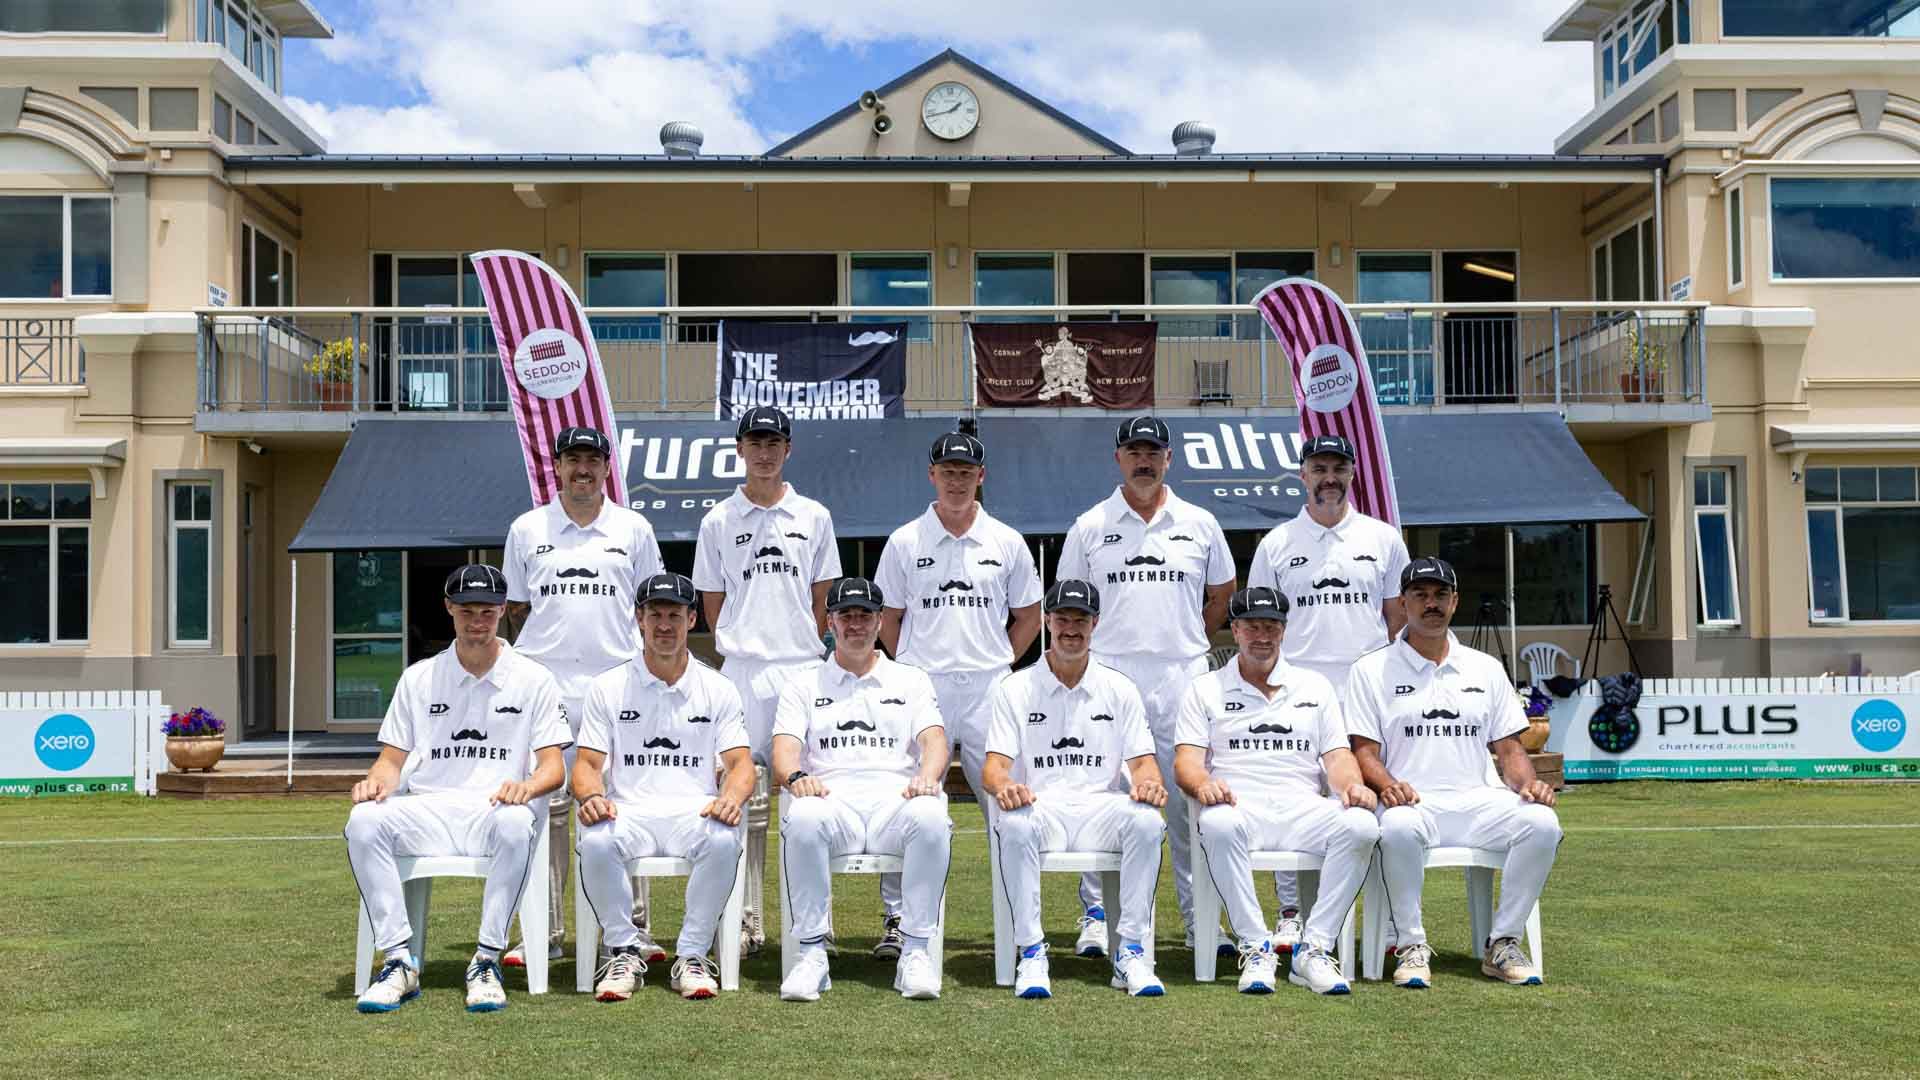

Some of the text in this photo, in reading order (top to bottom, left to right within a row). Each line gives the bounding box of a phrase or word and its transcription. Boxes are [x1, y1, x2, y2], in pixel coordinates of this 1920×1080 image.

[1102, 347, 1143, 356] NORTHLAND
[524, 360, 581, 381] SEDDON
[732, 351, 778, 380] THE
[983, 377, 1035, 386] CRICKET CLUB
[1096, 376, 1147, 385] NEW ZEALAND
[731, 379, 880, 407] MOVEMBER
[731, 402, 885, 420] ERATION
[1107, 570, 1185, 584] MOVEMBER
[540, 583, 616, 597] MOVEMBER
[922, 594, 989, 609] MOVEMBER
[1297, 592, 1368, 607] MOVEMBER
[1657, 704, 1798, 736] PLUS
[1856, 718, 1902, 733] xero
[1404, 724, 1477, 737] MOVEMBER
[40, 735, 90, 750] xero
[819, 735, 895, 750] MOVEMBER
[1229, 738, 1310, 752] MOVEMBER
[1726, 742, 1796, 750] accountants
[624, 753, 699, 767] MOVEMBER
[1034, 753, 1102, 768] MOVEMBER
